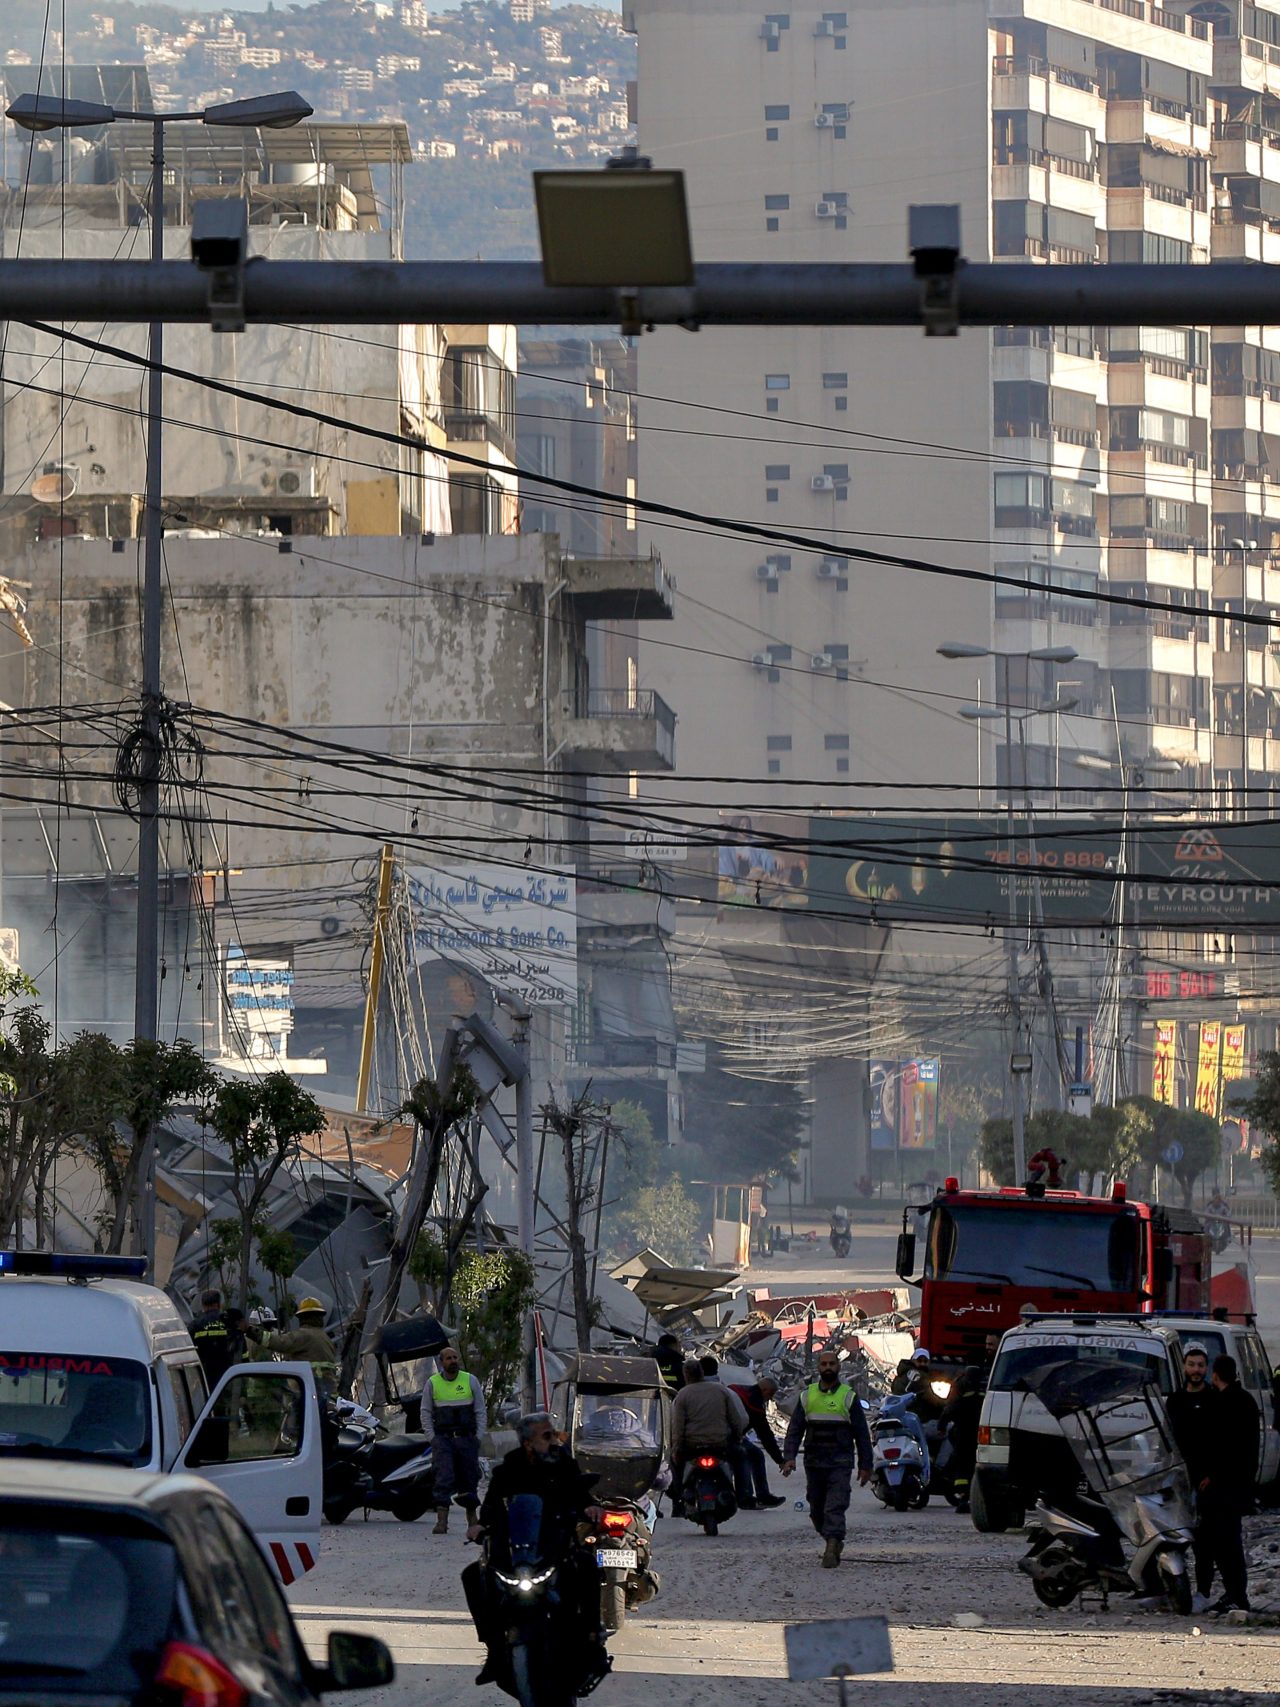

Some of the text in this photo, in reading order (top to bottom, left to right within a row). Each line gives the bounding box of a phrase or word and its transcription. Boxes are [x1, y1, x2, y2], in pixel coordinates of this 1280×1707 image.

[1064, 852, 1105, 867] 888
[528, 876, 568, 908] شركة
[1129, 885, 1271, 903] BEYROUTH
[547, 926, 568, 947] Co.
[1146, 971, 1171, 997] BIG
[950, 1302, 1001, 1316] المدني
